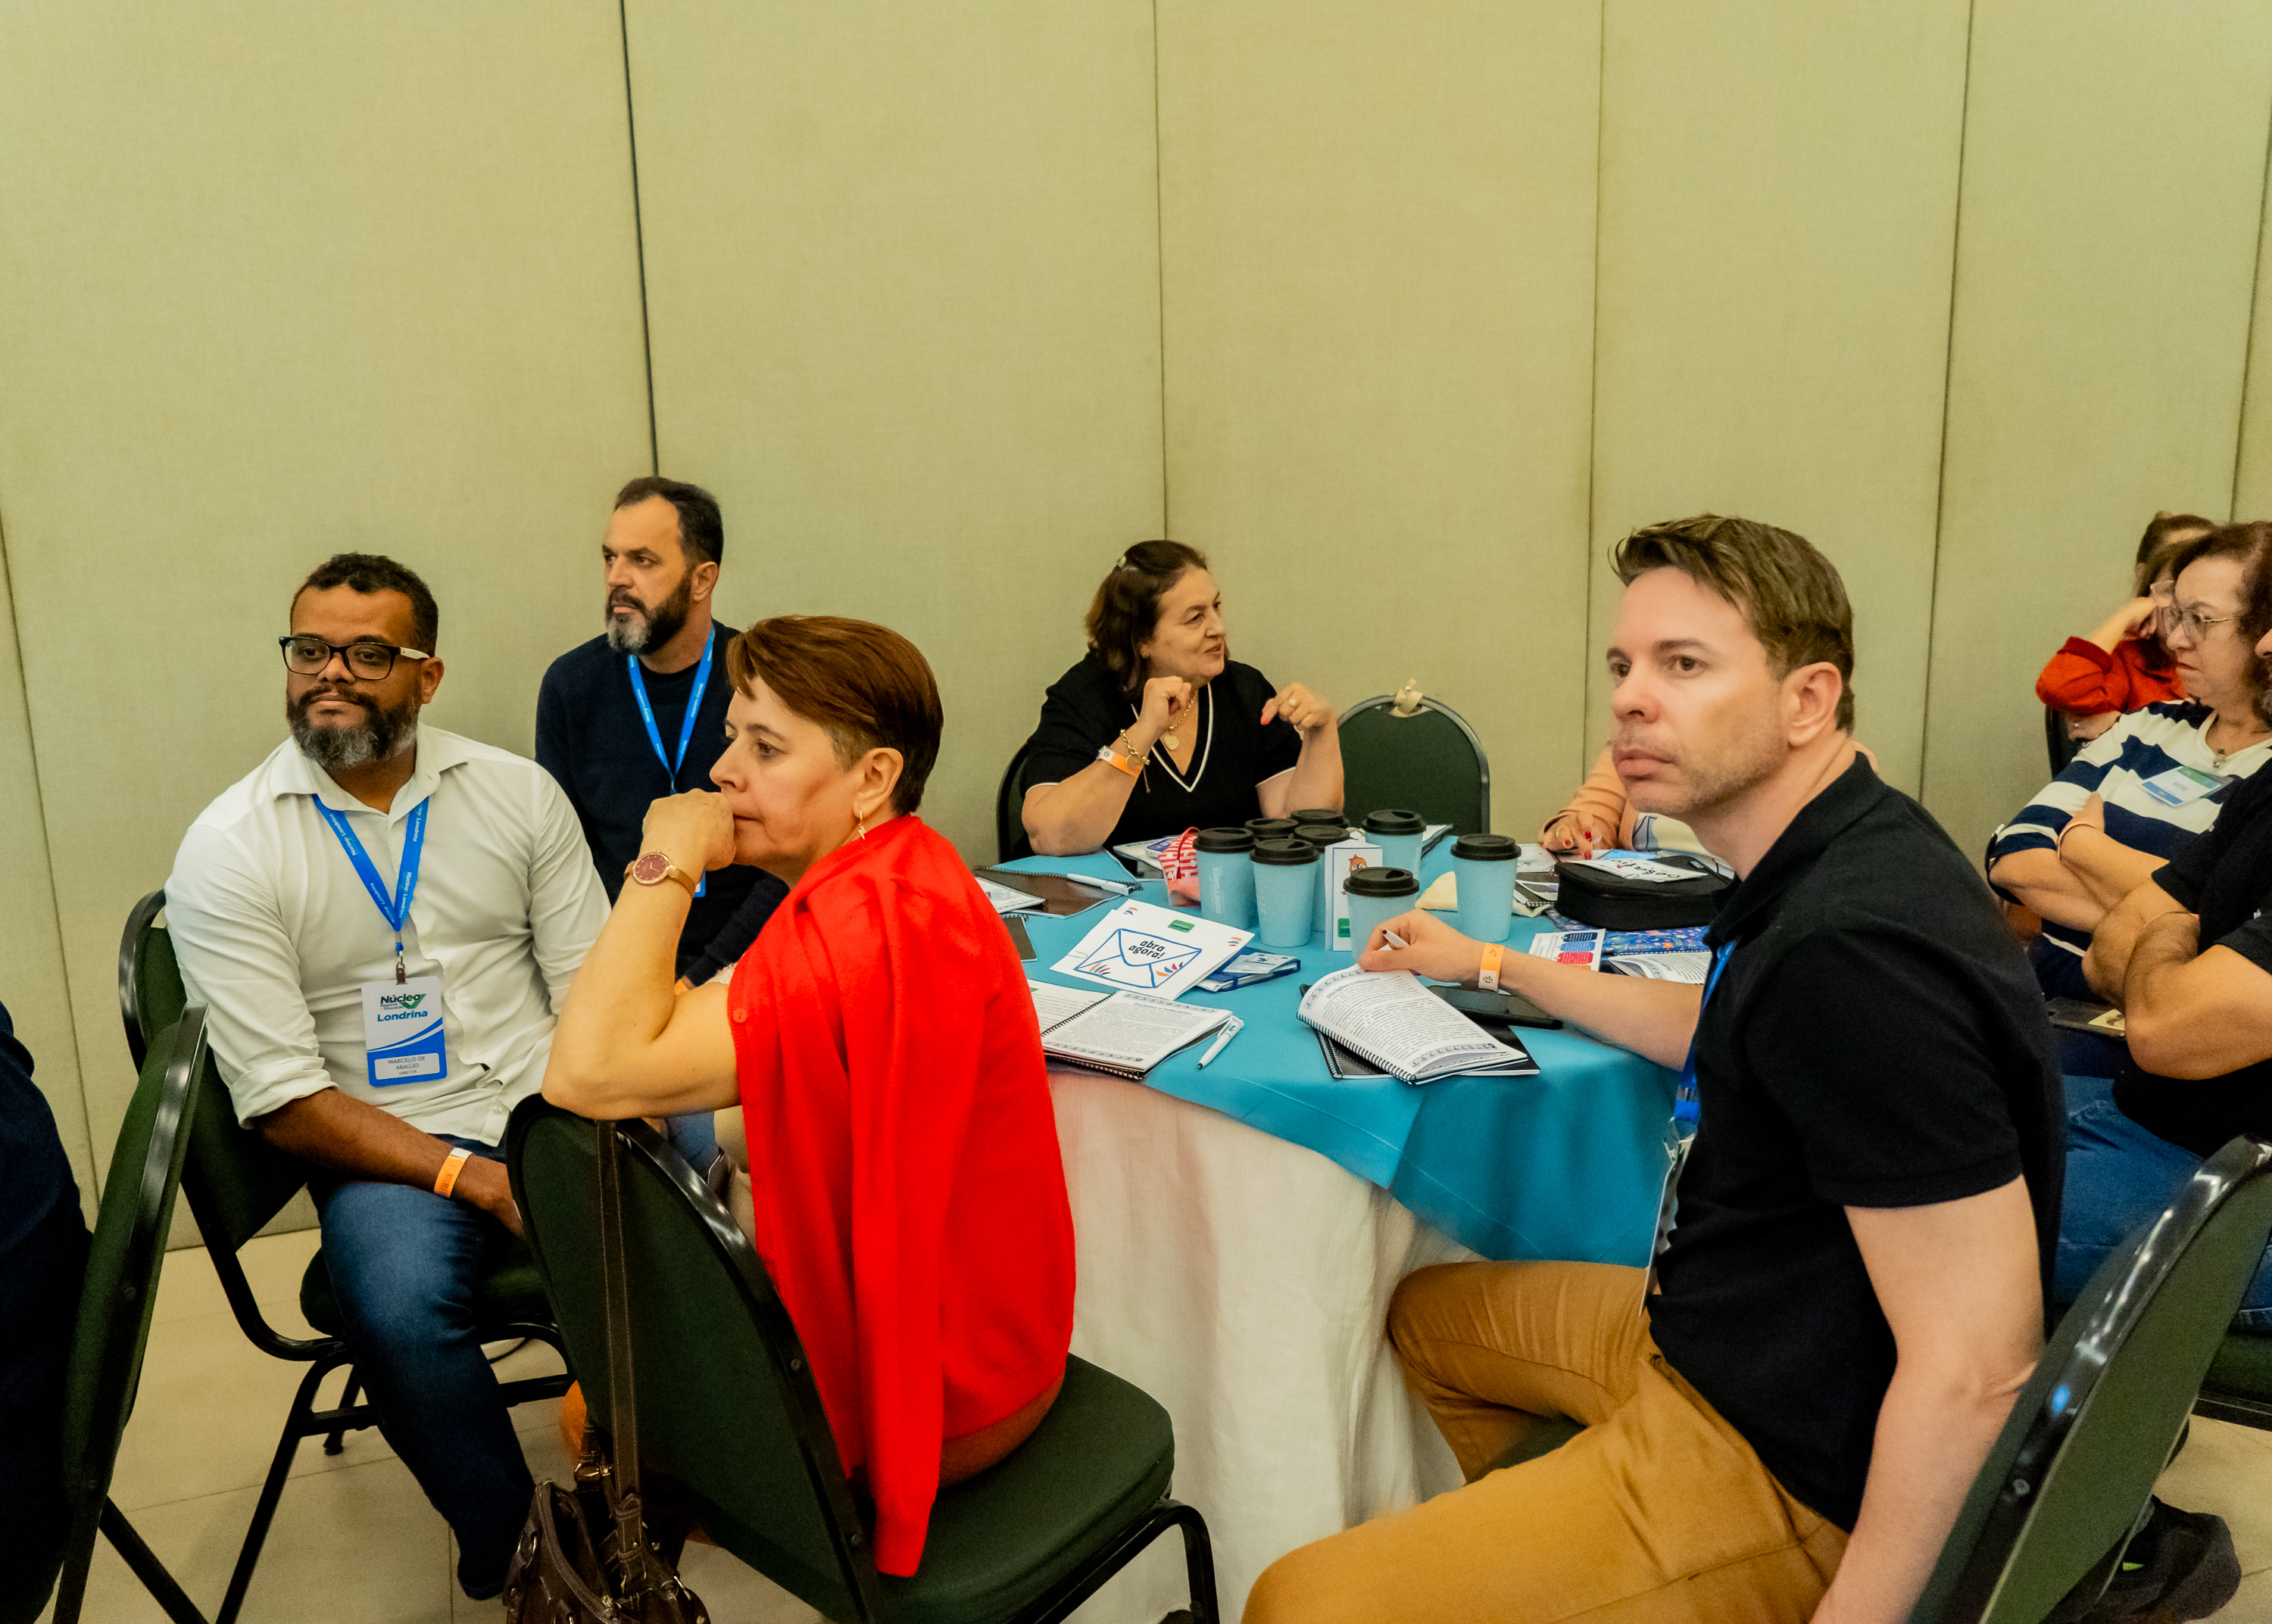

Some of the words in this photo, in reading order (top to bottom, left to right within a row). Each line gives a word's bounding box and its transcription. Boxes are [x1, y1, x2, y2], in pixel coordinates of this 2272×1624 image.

[329, 813, 345, 836] Londrina
[413, 818, 421, 842] Londrina
[1212, 867, 1222, 915] DIRETORES
[1128, 945, 1166, 959] agora!
[1140, 940, 1166, 952] abra
[380, 993, 421, 1005] Núcleo
[377, 1010, 428, 1022] Londrina
